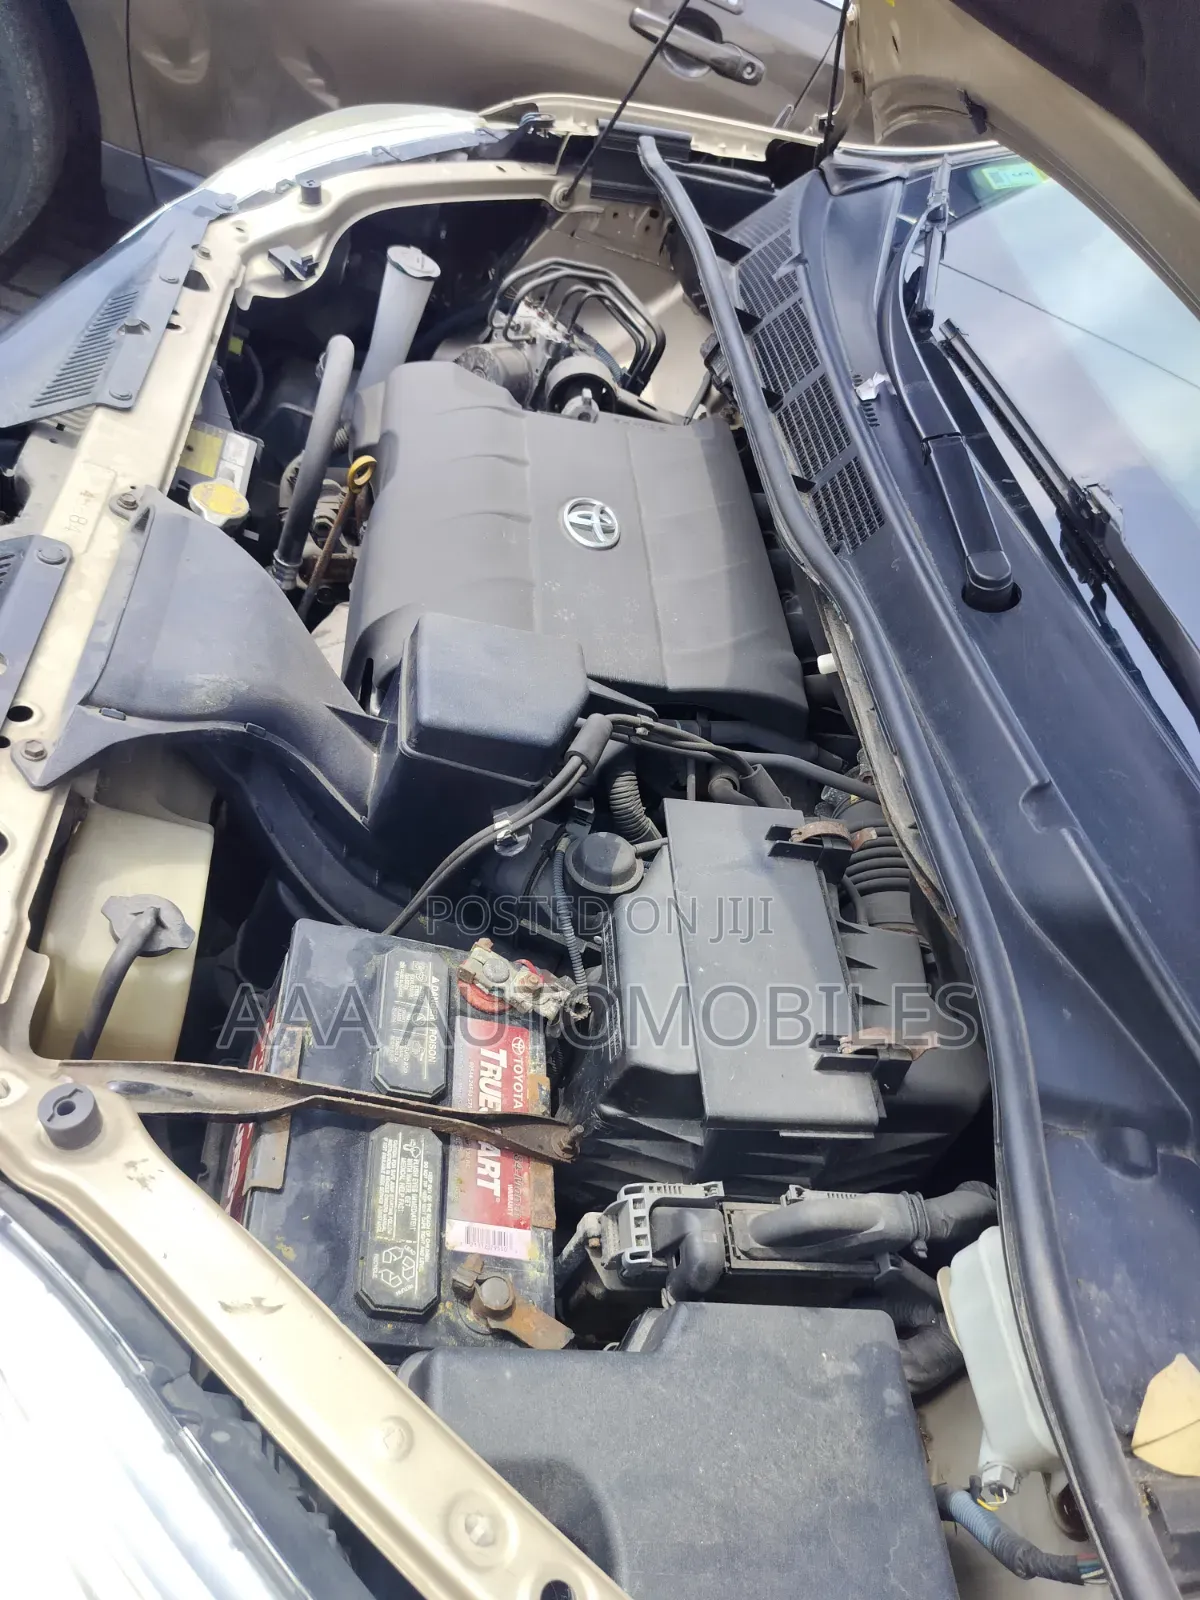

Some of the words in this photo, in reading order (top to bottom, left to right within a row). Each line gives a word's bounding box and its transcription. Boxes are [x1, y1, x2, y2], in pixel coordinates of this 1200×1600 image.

[430, 986, 439, 1020] DANGER
[428, 1029, 437, 1063] POISON
[512, 1058, 524, 1109] TOYOTA
[476, 1047, 507, 1198] TRUEART
